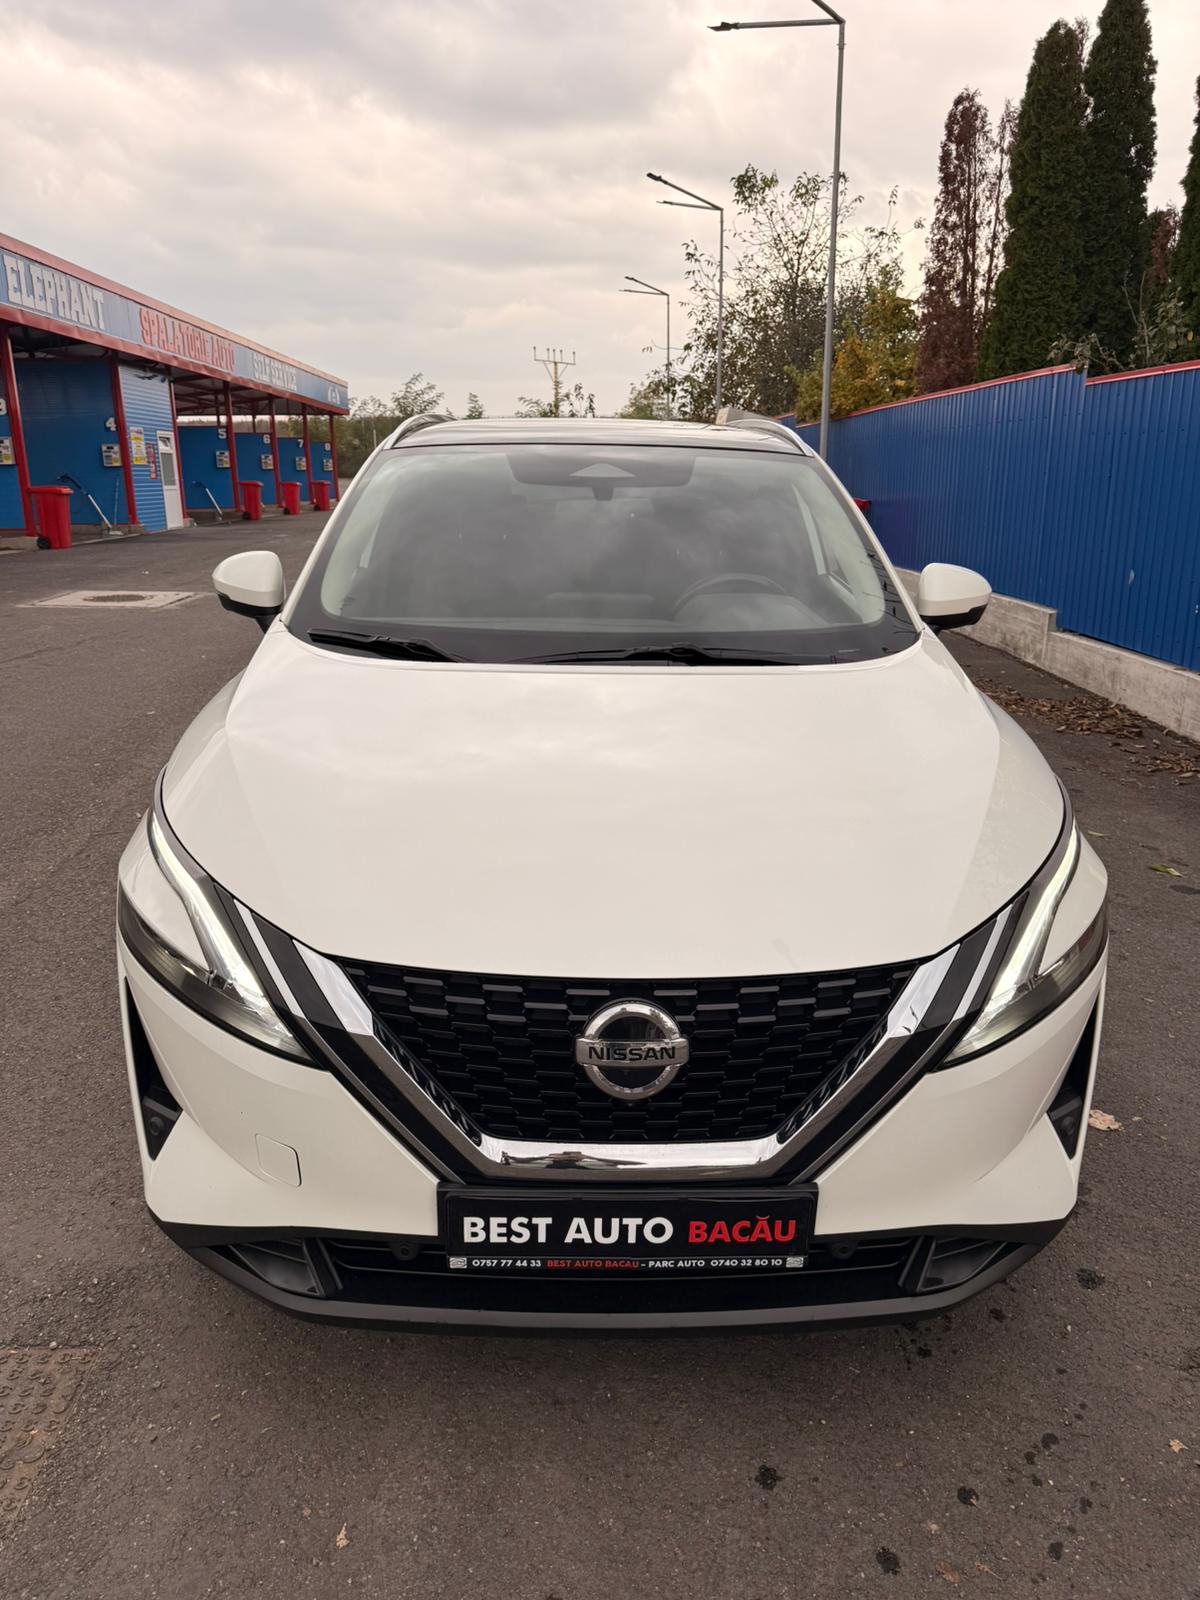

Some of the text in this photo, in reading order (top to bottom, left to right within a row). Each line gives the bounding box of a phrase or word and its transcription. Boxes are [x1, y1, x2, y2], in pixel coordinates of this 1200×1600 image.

[3, 254, 106, 330] ELEPHANT
[210, 335, 235, 371] AUTO
[270, 359, 297, 391] SERVICE
[105, 416, 117, 432] 4
[218, 428, 227, 439] 5
[262, 434, 271, 444] 6
[297, 438, 305, 448] 7
[588, 1046, 676, 1062] NISSAN
[463, 1214, 797, 1245] BEST AUTO BACĂU
[472, 1259, 498, 1267] 0757
[501, 1259, 513, 1267] 77
[515, 1259, 528, 1267] 44
[530, 1259, 542, 1267] 33
[547, 1260, 571, 1268] BEST
[574, 1260, 602, 1268] AUTO
[648, 1260, 675, 1268] PARC
[711, 1259, 739, 1267] 0740
[741, 1258, 753, 1266] 32
[771, 1258, 783, 1266] 10
